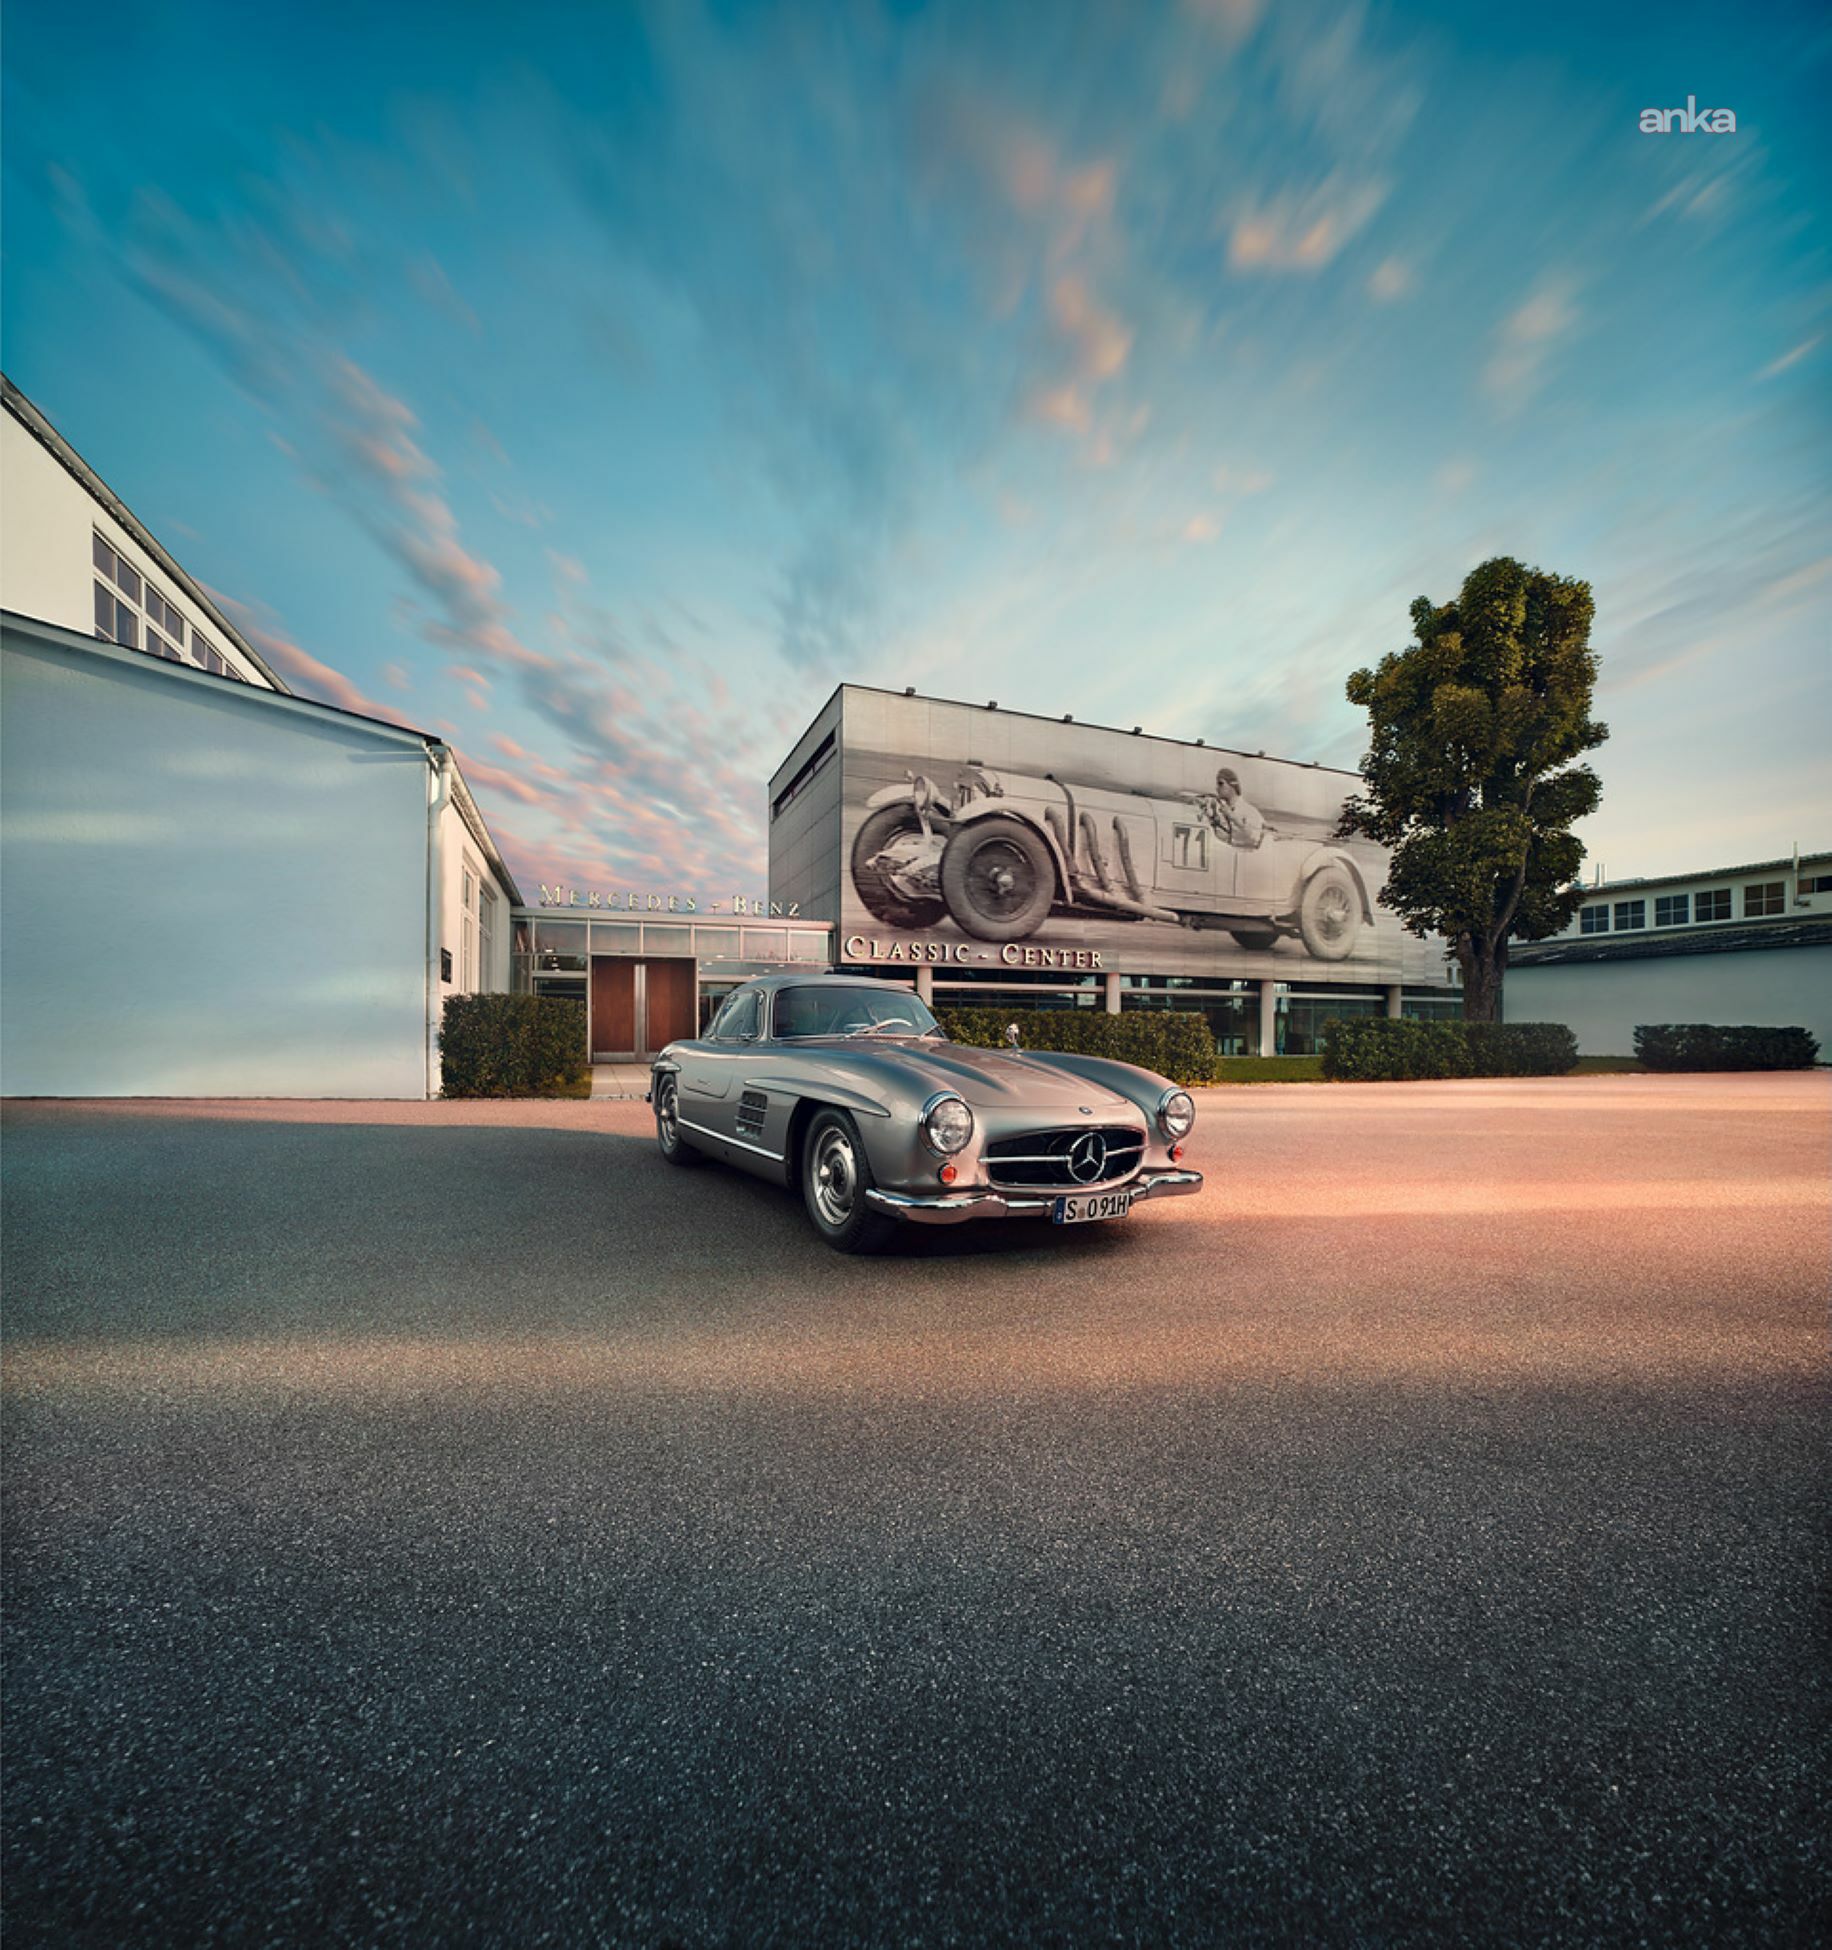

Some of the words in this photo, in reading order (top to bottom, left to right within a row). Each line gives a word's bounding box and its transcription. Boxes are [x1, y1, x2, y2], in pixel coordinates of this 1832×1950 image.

[1175, 828, 1206, 868] 71
[540, 884, 696, 911] MERCEDES
[732, 895, 802, 919] BENZ
[845, 935, 970, 962] CLASSIC
[1001, 943, 1104, 969] CENTER
